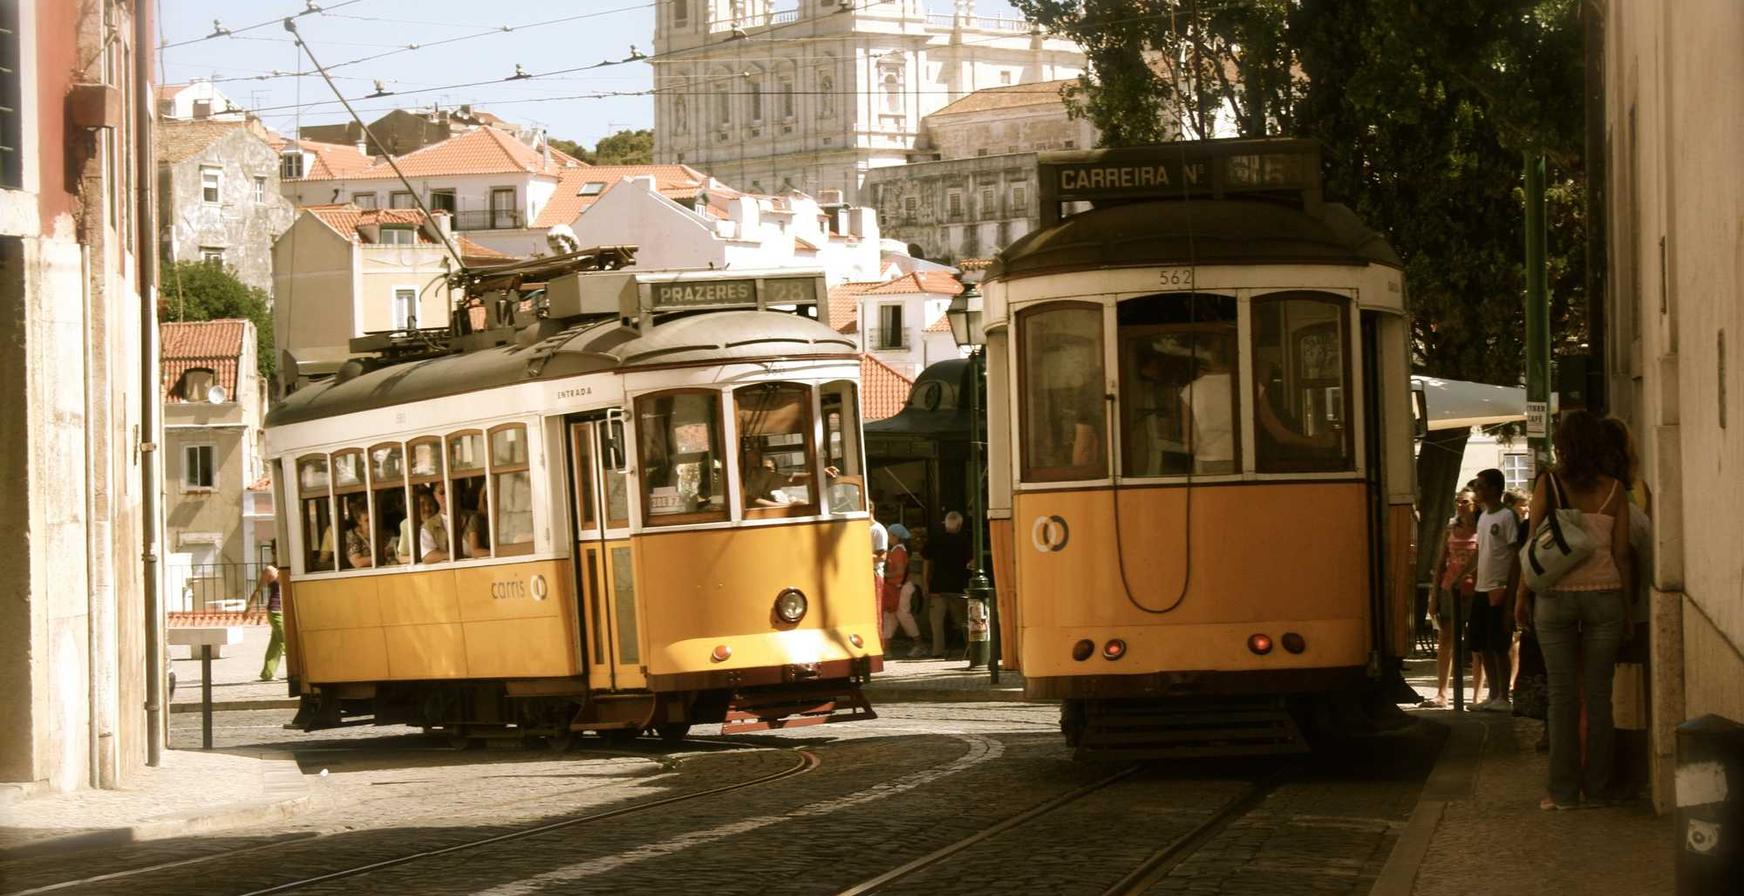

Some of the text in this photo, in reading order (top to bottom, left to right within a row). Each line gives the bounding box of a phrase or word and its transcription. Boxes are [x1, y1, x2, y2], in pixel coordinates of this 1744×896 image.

[1061, 166, 1169, 190] CARREIRA
[1160, 269, 1191, 285] 562
[660, 284, 748, 302] PRAZERES
[490, 573, 526, 600] carris
